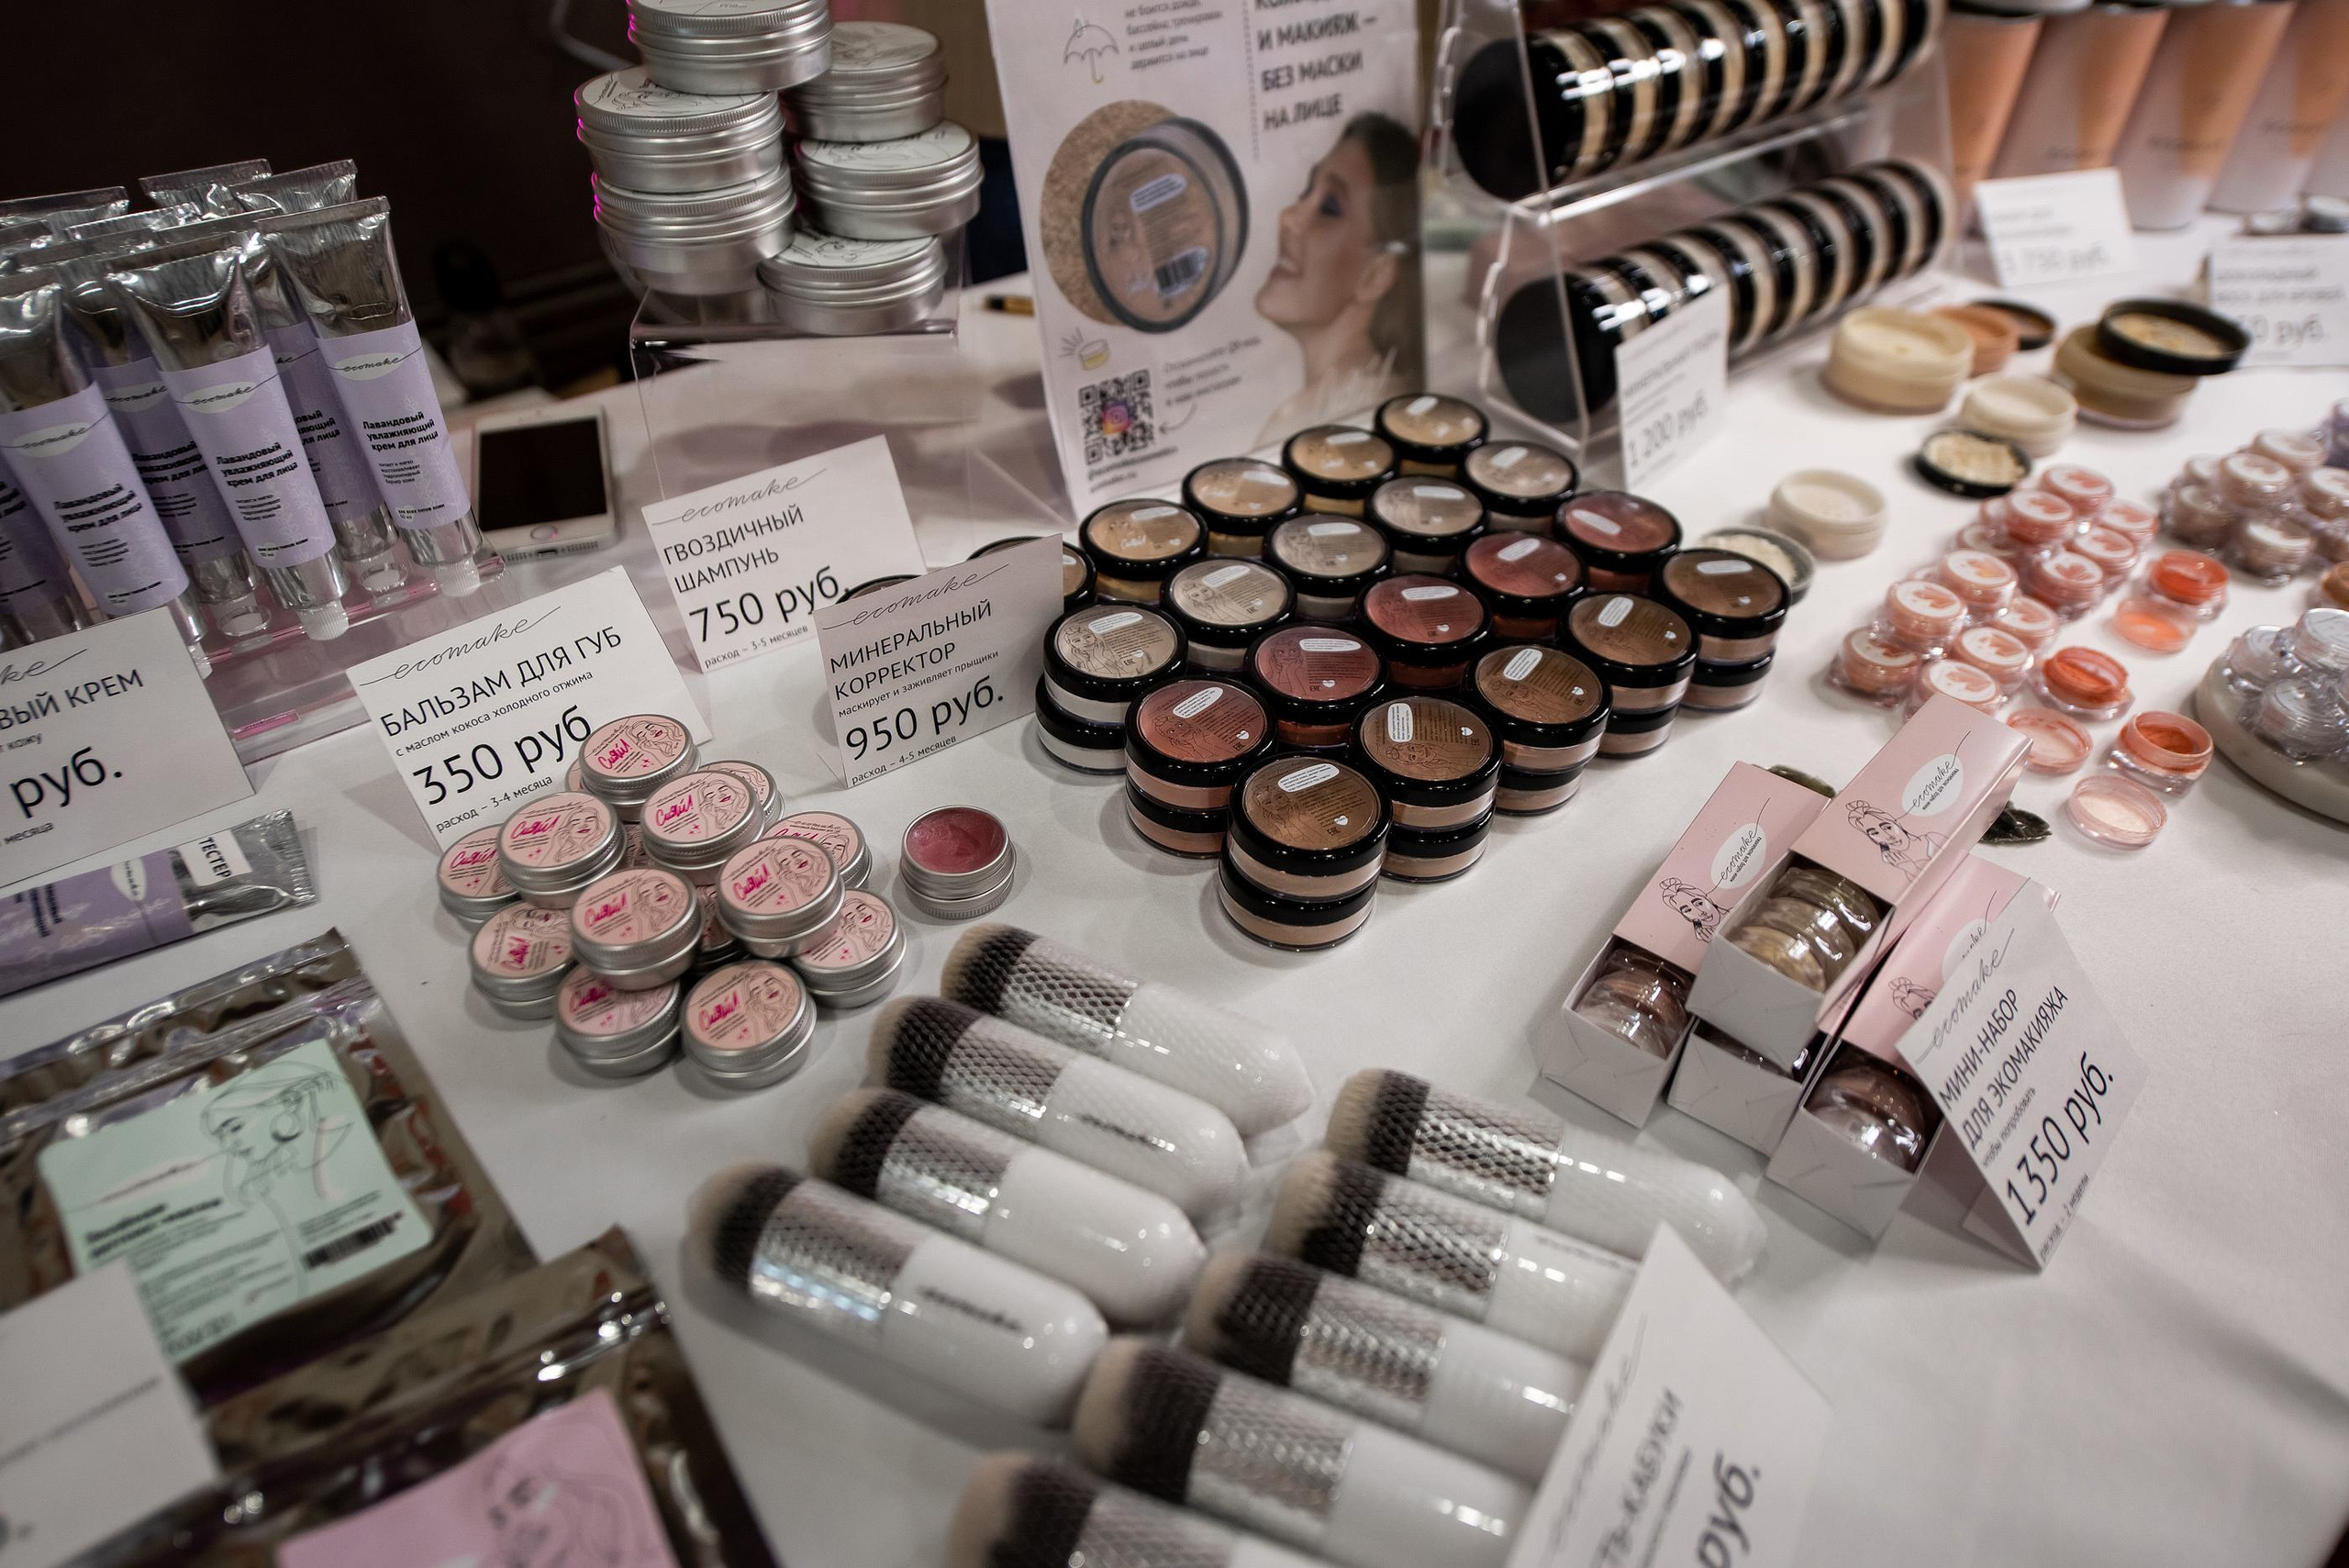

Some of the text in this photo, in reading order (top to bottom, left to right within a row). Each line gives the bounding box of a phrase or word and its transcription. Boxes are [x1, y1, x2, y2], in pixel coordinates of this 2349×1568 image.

[1257, 30, 1272, 51] И
[1276, 11, 1360, 48] МАКИЯЖ
[1261, 50, 1364, 92] БЕЗ МАСКИ
[1264, 94, 1344, 131] НА ЛИЦЕ
[362, 412, 425, 429] Лавандовый
[366, 419, 436, 441] увлажняющий
[372, 430, 439, 451] крем для лица
[217, 442, 282, 464] Лавандовый
[221, 450, 294, 477] увлажняющий
[227, 462, 298, 488] крем для лица
[656, 471, 817, 525] ecomake
[663, 504, 805, 565] ГВОЗДИЧНЫЙ
[674, 547, 780, 594] ШАМПУНЬ
[688, 592, 765, 643] 750
[829, 566, 1000, 629] ecomake
[374, 611, 551, 684] ecomake
[704, 649, 740, 669] расход
[769, 624, 809, 648] месяцев
[829, 598, 992, 673] МИНЕРАЛЬНЫЙ
[64, 668, 145, 709] КРЕМ
[380, 626, 622, 736] БАЛЬЗАМ ДЛЯ ГУБ
[835, 642, 956, 701] КОРРЕКТОР
[838, 651, 999, 718] маскирует и заживляет прыщики
[395, 671, 595, 758] с маслом кокоса холодного отжима
[845, 674, 1004, 761] 950 руб.
[413, 744, 504, 806] 350
[598, 738, 633, 771] Сияй!
[852, 763, 887, 785] расход
[899, 751, 916, 765] 4-5
[918, 735, 957, 757] месяцев
[9, 746, 123, 819] руб.
[435, 806, 480, 834] расход
[489, 791, 512, 810] 3-4
[513, 776, 553, 800] месяца
[1911, 758, 1956, 810] ecomake
[655, 794, 695, 828] Сияй!
[198, 836, 232, 879] ТЕСТЕР
[1720, 828, 1757, 882] ecomake
[1923, 938, 2008, 1058] ecomake
[1938, 988, 2021, 1112] МИНИ-НАБОР
[1961, 985, 2069, 1151] ДЛЯ ЭКОМАКИЯЖА
[2007, 1051, 2114, 1226] 1350 руб.
